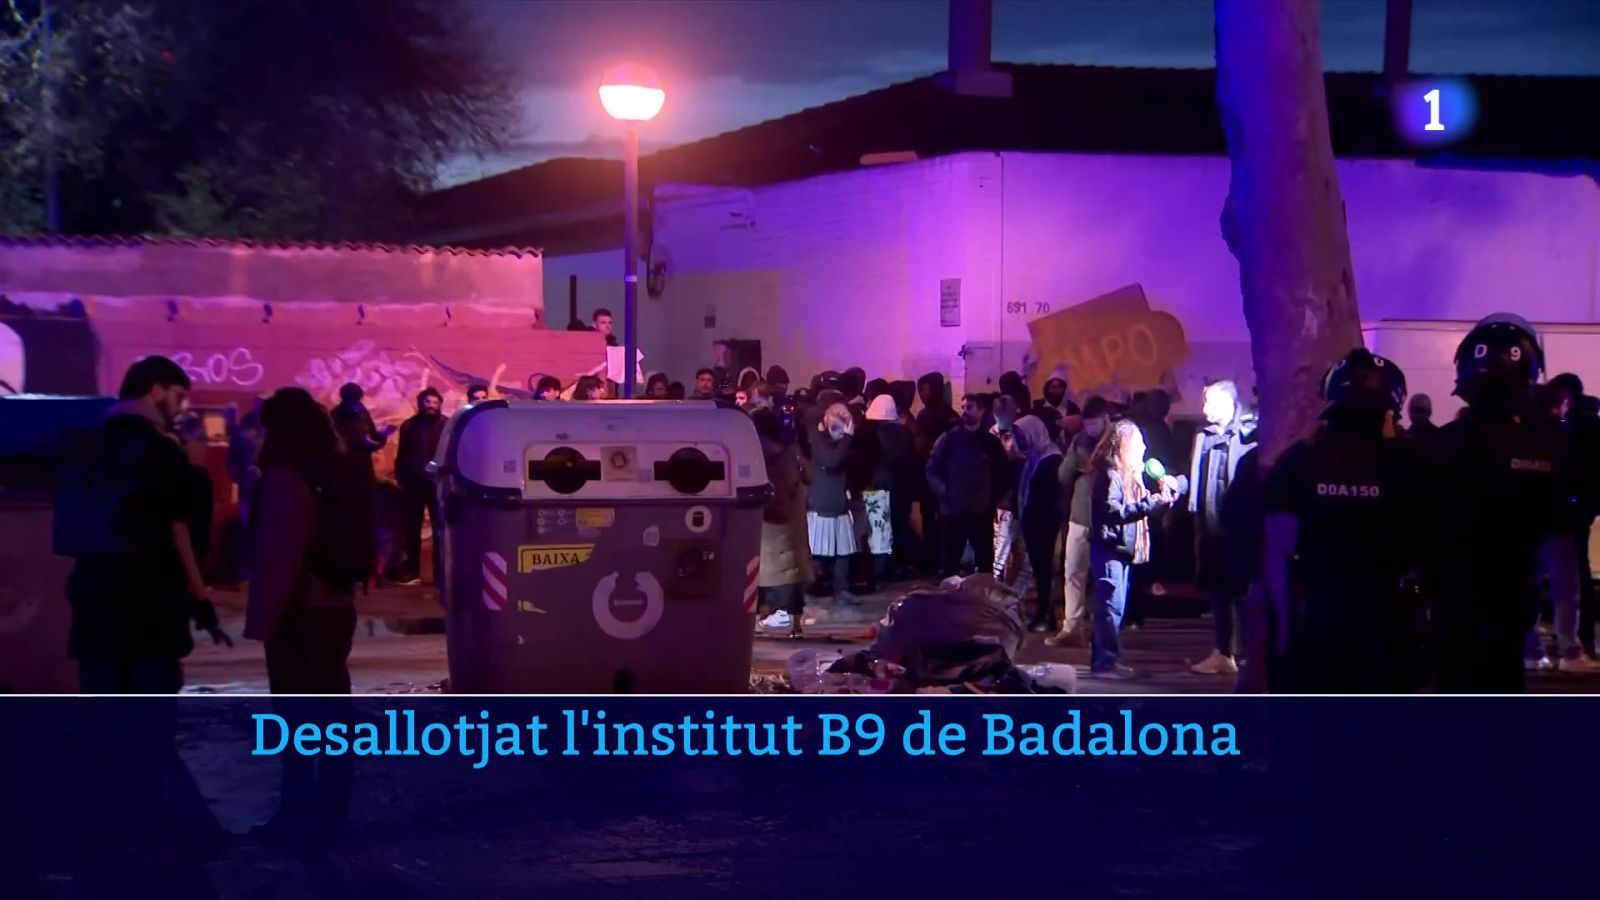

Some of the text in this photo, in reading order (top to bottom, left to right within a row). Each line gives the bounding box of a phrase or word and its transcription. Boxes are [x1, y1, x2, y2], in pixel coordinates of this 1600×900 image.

[1035, 301, 1050, 314] 70
[1474, 344, 1521, 361] D 9
[532, 553, 580, 566] BAIXA
